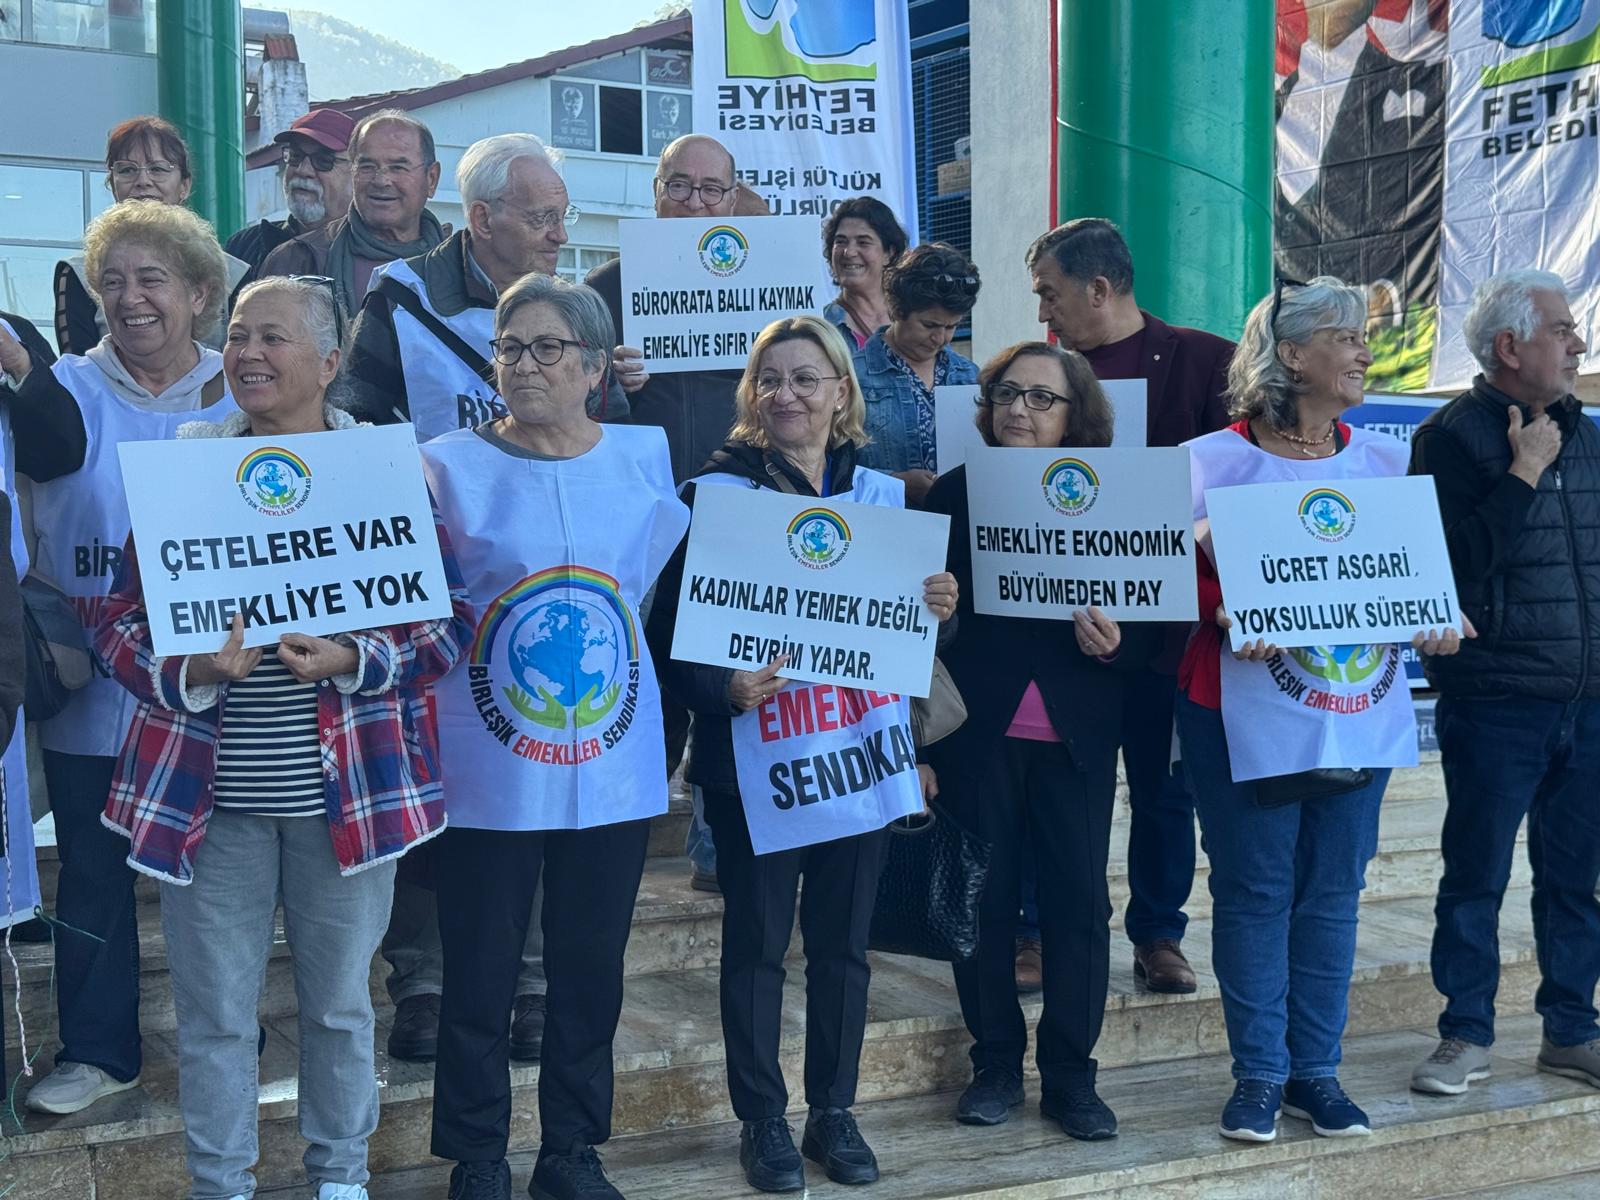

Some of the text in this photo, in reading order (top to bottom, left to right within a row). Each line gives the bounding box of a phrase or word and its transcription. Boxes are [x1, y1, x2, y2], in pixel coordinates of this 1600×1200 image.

[1482, 75, 1596, 131] FETH
[632, 286, 815, 316] BÜROKRATA BALLI KAYMAK
[643, 329, 709, 360] EMEKLİYE
[714, 332, 748, 356] SIFIR
[160, 515, 418, 581] ÇETELERE VAR
[976, 522, 1187, 557] EMEKLİYE EKONOMİK
[999, 570, 1163, 606] BÜYÜMEDEN PAY
[1261, 554, 1328, 584] ÜCRET
[170, 571, 430, 635] EMEKLİYE YOK
[689, 574, 929, 641] KADINLAR YEMEK DEĞİL,
[1234, 592, 1452, 635] YOKSULLUK SÜREKLİ
[728, 632, 875, 681] DEVRİM YAPAR.
[468, 661, 640, 766] BİRLEŞİK EMEKLİLER SENDİKASI
[1303, 689, 1369, 714] EMEKLİLER
